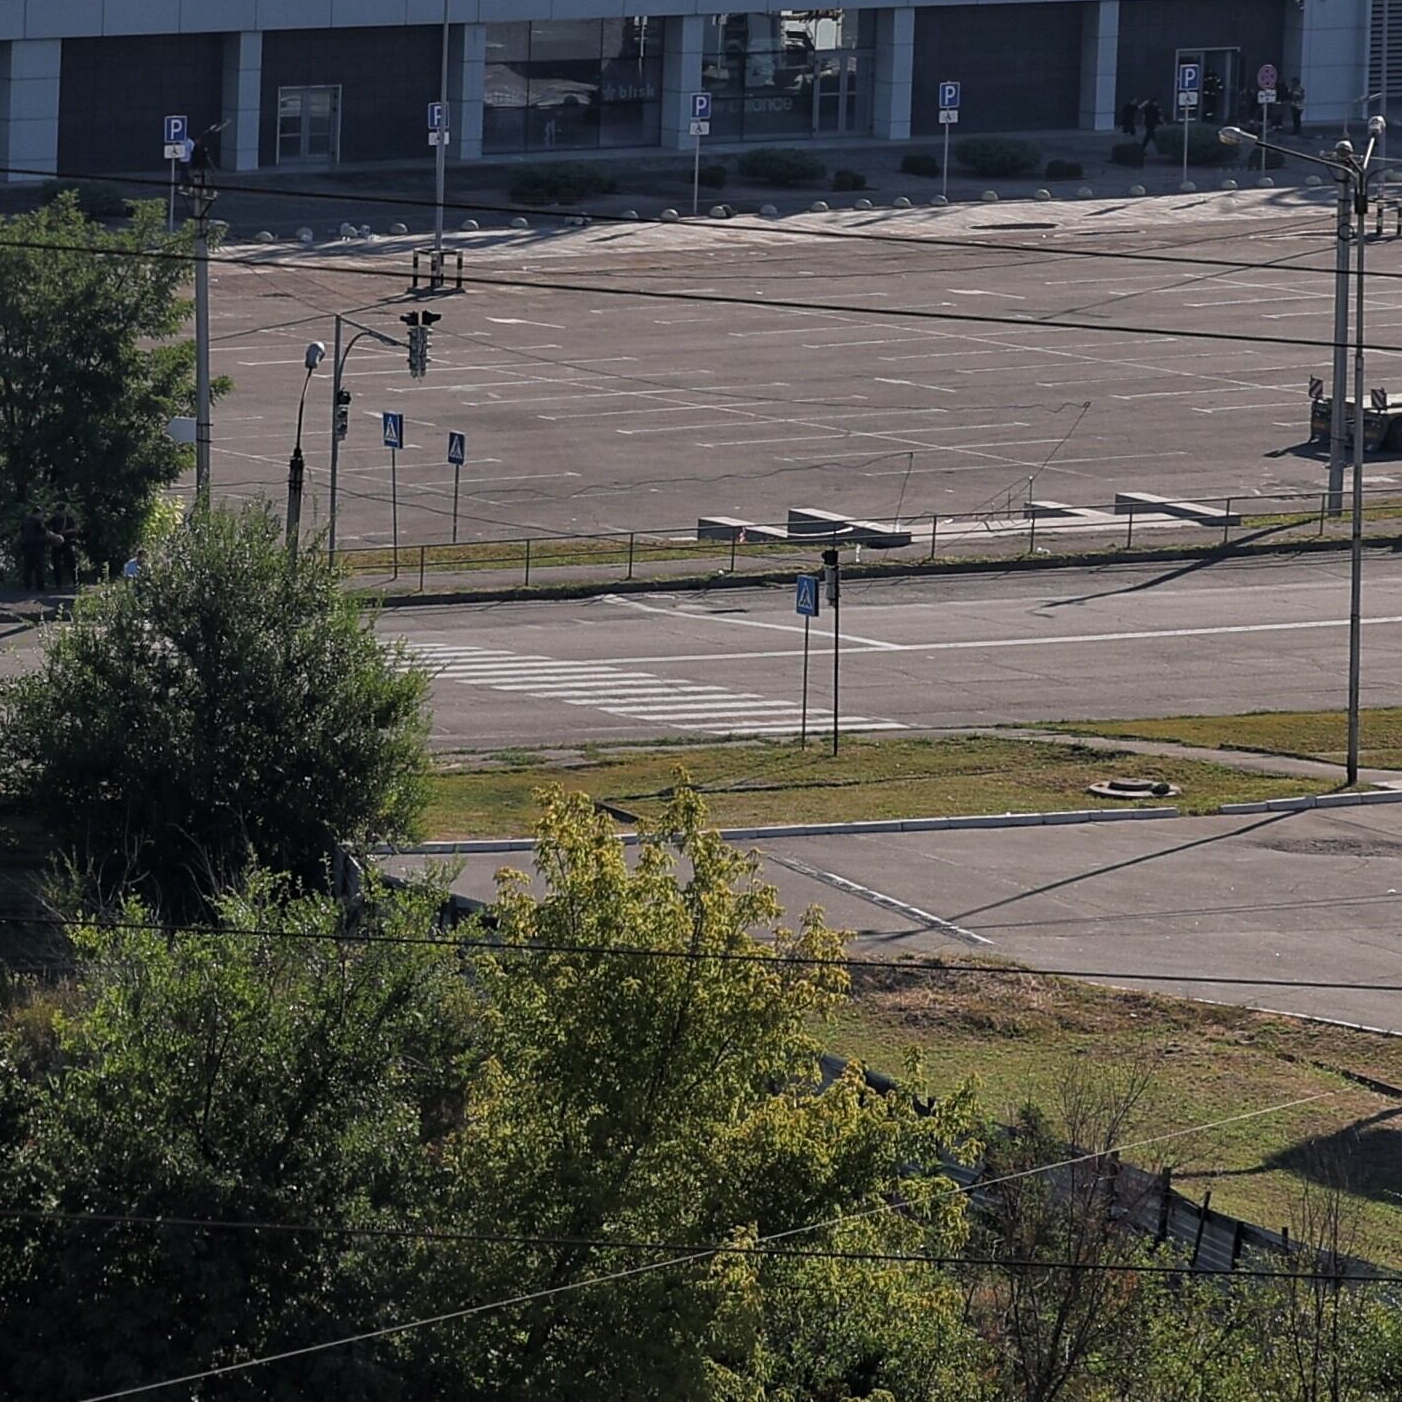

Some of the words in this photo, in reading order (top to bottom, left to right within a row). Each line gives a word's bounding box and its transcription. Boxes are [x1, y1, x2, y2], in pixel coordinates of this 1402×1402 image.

[1184, 67, 1195, 89] P
[696, 96, 708, 116] P
[945, 85, 956, 106] P
[170, 119, 182, 140] P
